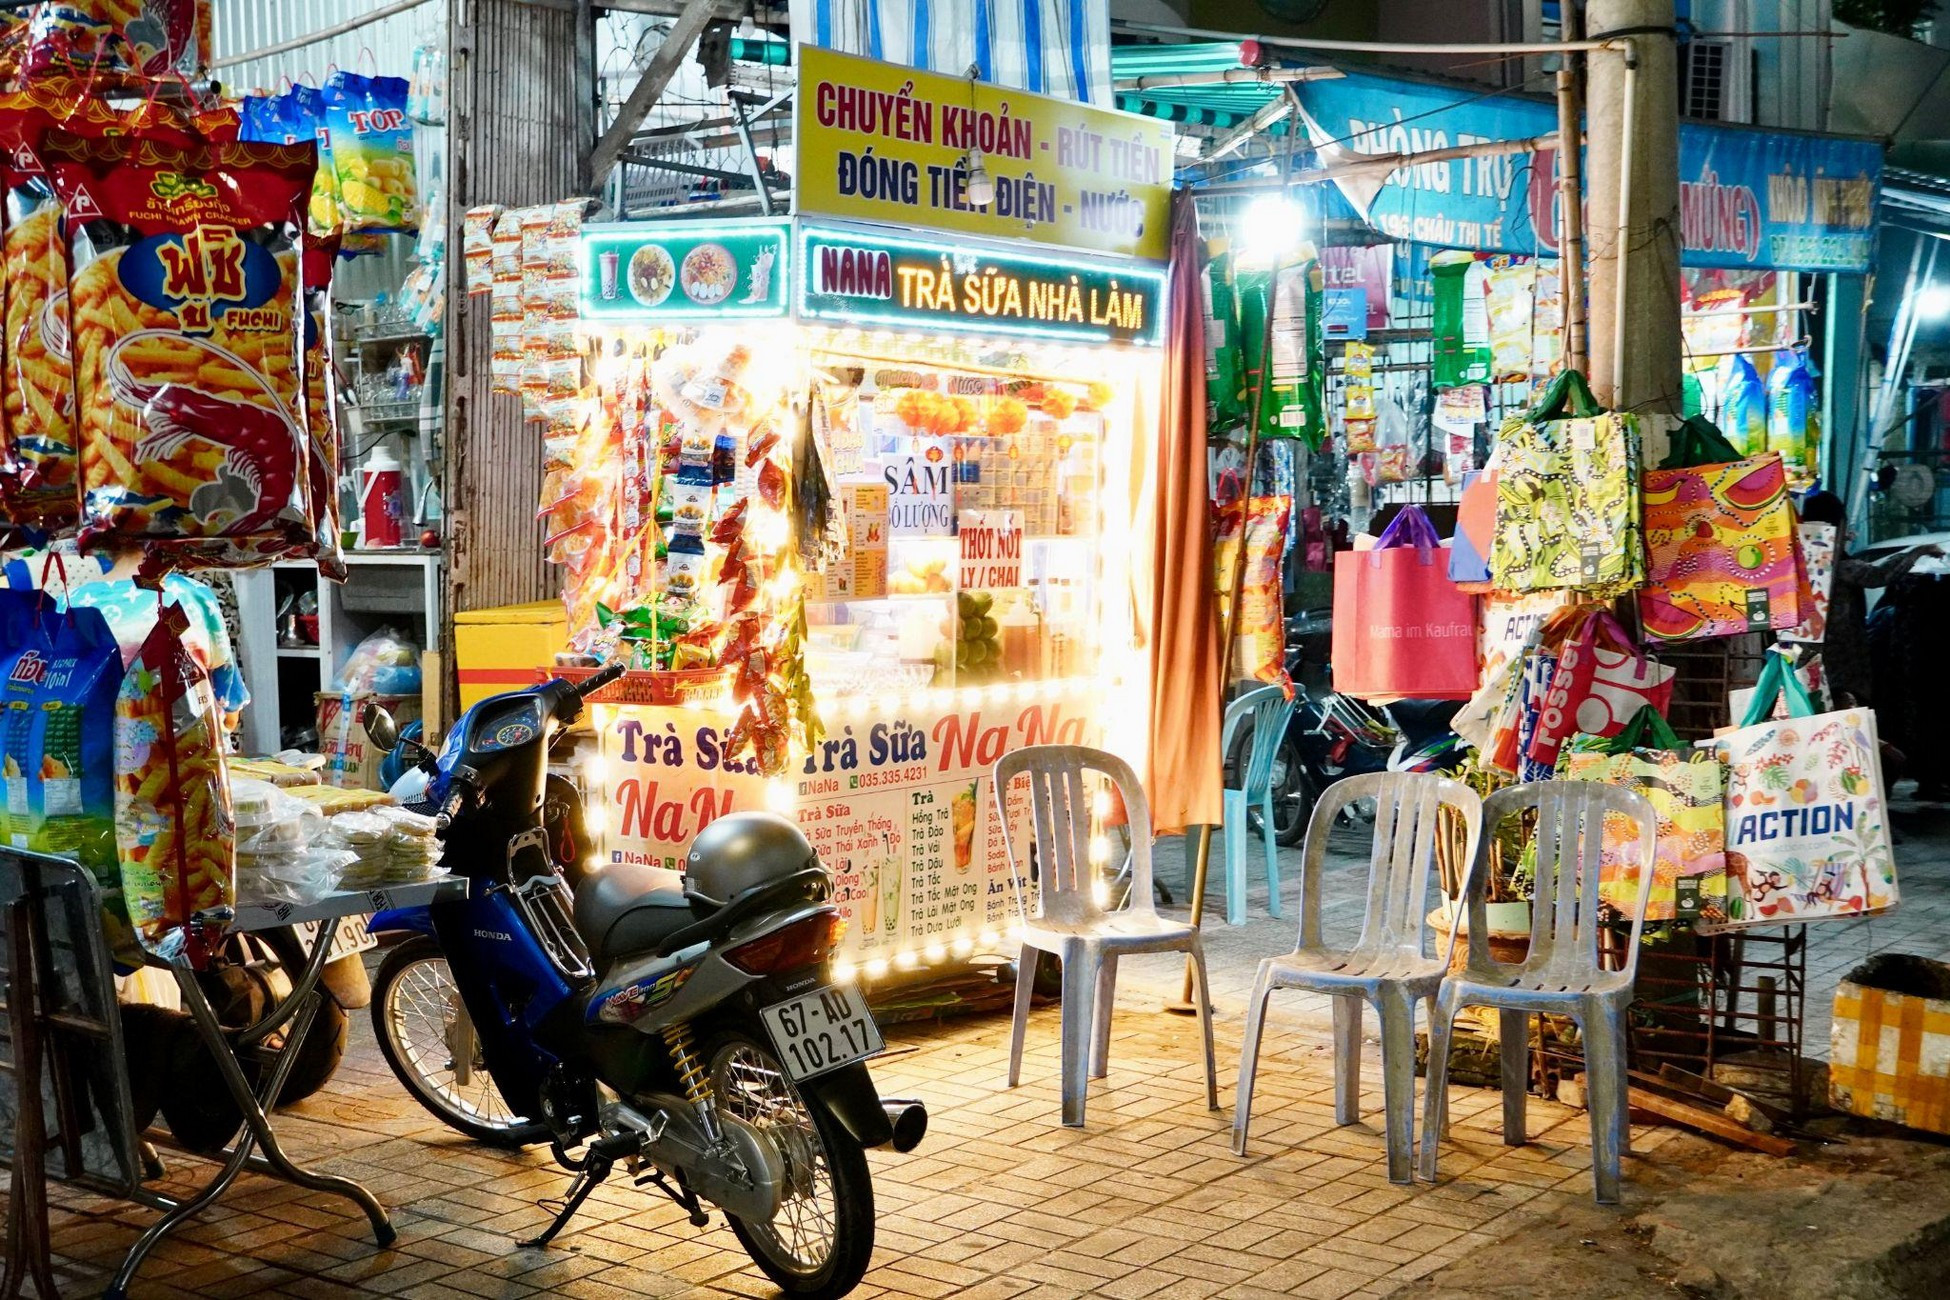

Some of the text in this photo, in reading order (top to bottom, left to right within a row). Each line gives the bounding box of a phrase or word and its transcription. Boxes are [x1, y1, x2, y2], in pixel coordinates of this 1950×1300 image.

[349, 109, 404, 134] TOP
[817, 81, 933, 144] CHUYỂN
[943, 102, 1031, 160] KHOẢN
[1058, 123, 1102, 173] RÚT
[1110, 132, 1160, 185] TIỀN
[838, 147, 918, 205] ĐÓNG
[927, 157, 988, 214] TIỀ
[996, 171, 1055, 223] ĐIỆN
[1081, 188, 1145, 238] NƯỚC
[129, 211, 251, 226] FUCHI PRAWN CRACKER
[1414, 212, 1455, 243] CHÂU
[822, 247, 1143, 329] NANA TRÀ SỮA NHÀ LÀM
[226, 312, 280, 329] FUCHI
[884, 457, 949, 495] SÂM
[904, 501, 949, 533] LƯỢNG
[961, 567, 975, 588] LY
[988, 566, 1019, 588] CHAI
[617, 720, 684, 767] Trà
[870, 720, 927, 766] Sữa
[808, 766, 928, 795] NaNa 035.335.4231
[1014, 776, 1031, 791] Biệ
[912, 790, 934, 805] Trà
[616, 778, 688, 844] Na
[798, 804, 851, 823] Trà Sữa
[912, 808, 948, 825] Hồng Trà
[1737, 802, 1853, 845] ACTION
[815, 827, 832, 840] Sữa
[912, 826, 944, 840] Trà Đào
[836, 840, 853, 853] Thái
[912, 844, 924, 857] Trà
[987, 850, 1005, 861] Soda
[625, 851, 661, 867] NaNa
[912, 861, 924, 873] Trà
[835, 874, 859, 887] Olong
[911, 871, 941, 889] Trà Tắc
[988, 879, 1004, 895] Ăn
[911, 893, 924, 905] Trà
[928, 887, 941, 901] Tắc
[963, 883, 977, 896] Ong
[911, 909, 924, 921] Trà
[473, 928, 512, 941] HONDA
[911, 925, 923, 937] Trà
[786, 977, 816, 991] HONDA
[606, 984, 640, 1006] WAVE
[778, 989, 852, 1038] 67-AD
[789, 1018, 869, 1074] 102.17
